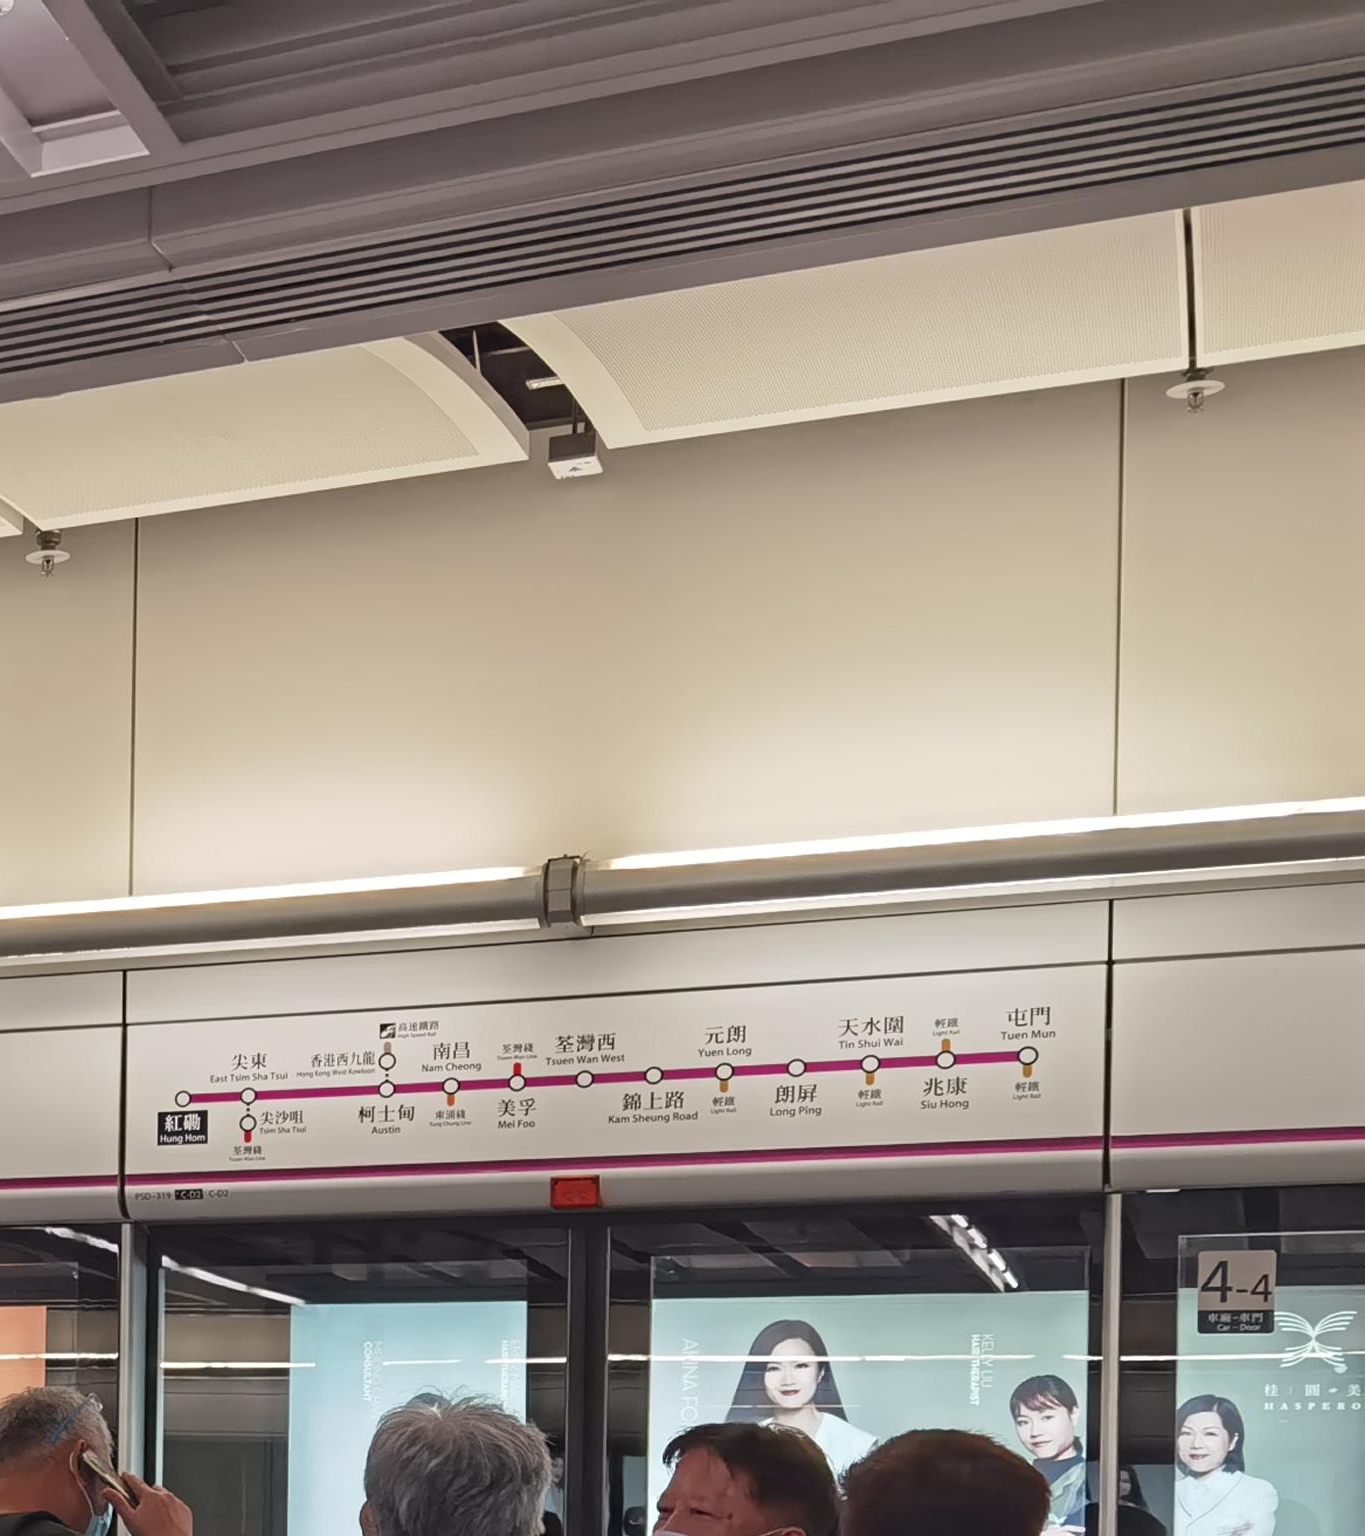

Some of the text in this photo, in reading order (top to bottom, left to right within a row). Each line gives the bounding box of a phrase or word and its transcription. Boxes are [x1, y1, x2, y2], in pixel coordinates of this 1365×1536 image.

[1006, 1006, 1052, 1027] 屯門
[837, 1015, 904, 1037] 天水圍
[555, 1032, 617, 1054] 荃灣西
[705, 1025, 747, 1045] 元朗
[838, 1037, 904, 1050] Tin Shui Wai
[1000, 1029, 1056, 1041] Tuen Mun
[433, 1041, 471, 1060] 南昌
[698, 1047, 752, 1057] Yuen Long
[231, 1052, 268, 1070] 尖東
[310, 1051, 376, 1068] 香港西九龍
[421, 1061, 482, 1072] Nam Cheong
[545, 1053, 625, 1066] Tsuen Wan West
[210, 1072, 288, 1083] East Tsim Sha Tsui
[774, 1084, 818, 1104] 朗屏
[923, 1076, 968, 1097] 兆康
[497, 1097, 537, 1117] 美孚
[622, 1091, 685, 1111] 錦上路
[920, 1100, 970, 1110] Siu Hong
[259, 1110, 304, 1125] 尖沙咀
[358, 1104, 415, 1124] 柯士甸
[608, 1112, 699, 1124] Kam Sheung Road
[769, 1106, 822, 1117] Long Ping
[164, 1113, 201, 1132] 紅磡
[371, 1125, 401, 1134] Austin
[498, 1119, 535, 1129] Mei Foo
[159, 1133, 206, 1145] Hung Hom
[1200, 1260, 1273, 1303] 4-4
